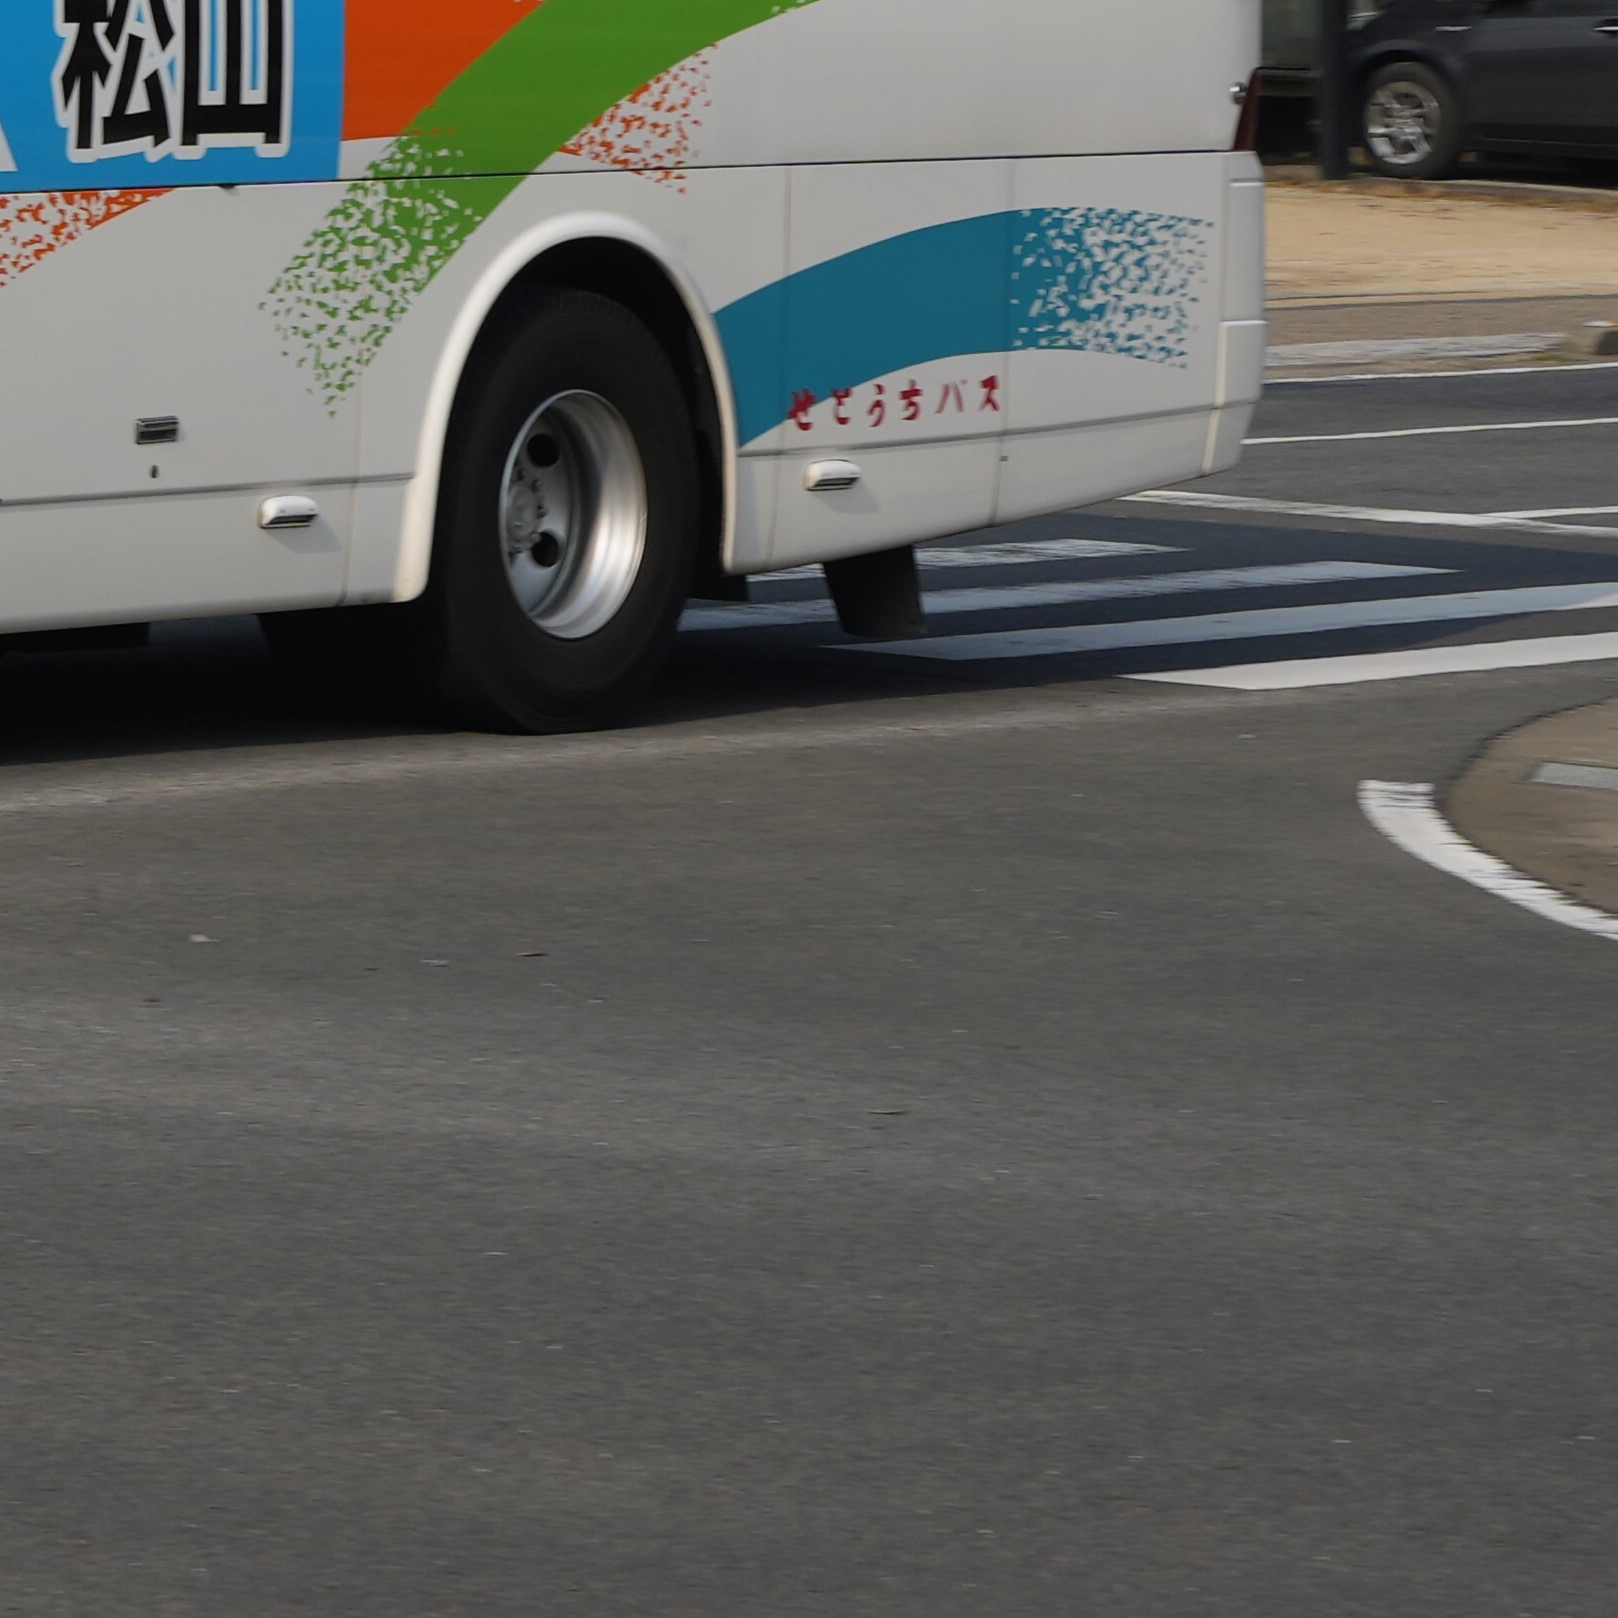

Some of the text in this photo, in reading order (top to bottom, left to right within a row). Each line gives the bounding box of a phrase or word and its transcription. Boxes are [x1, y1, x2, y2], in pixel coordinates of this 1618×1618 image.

[788, 374, 1002, 431] せとうちバス
